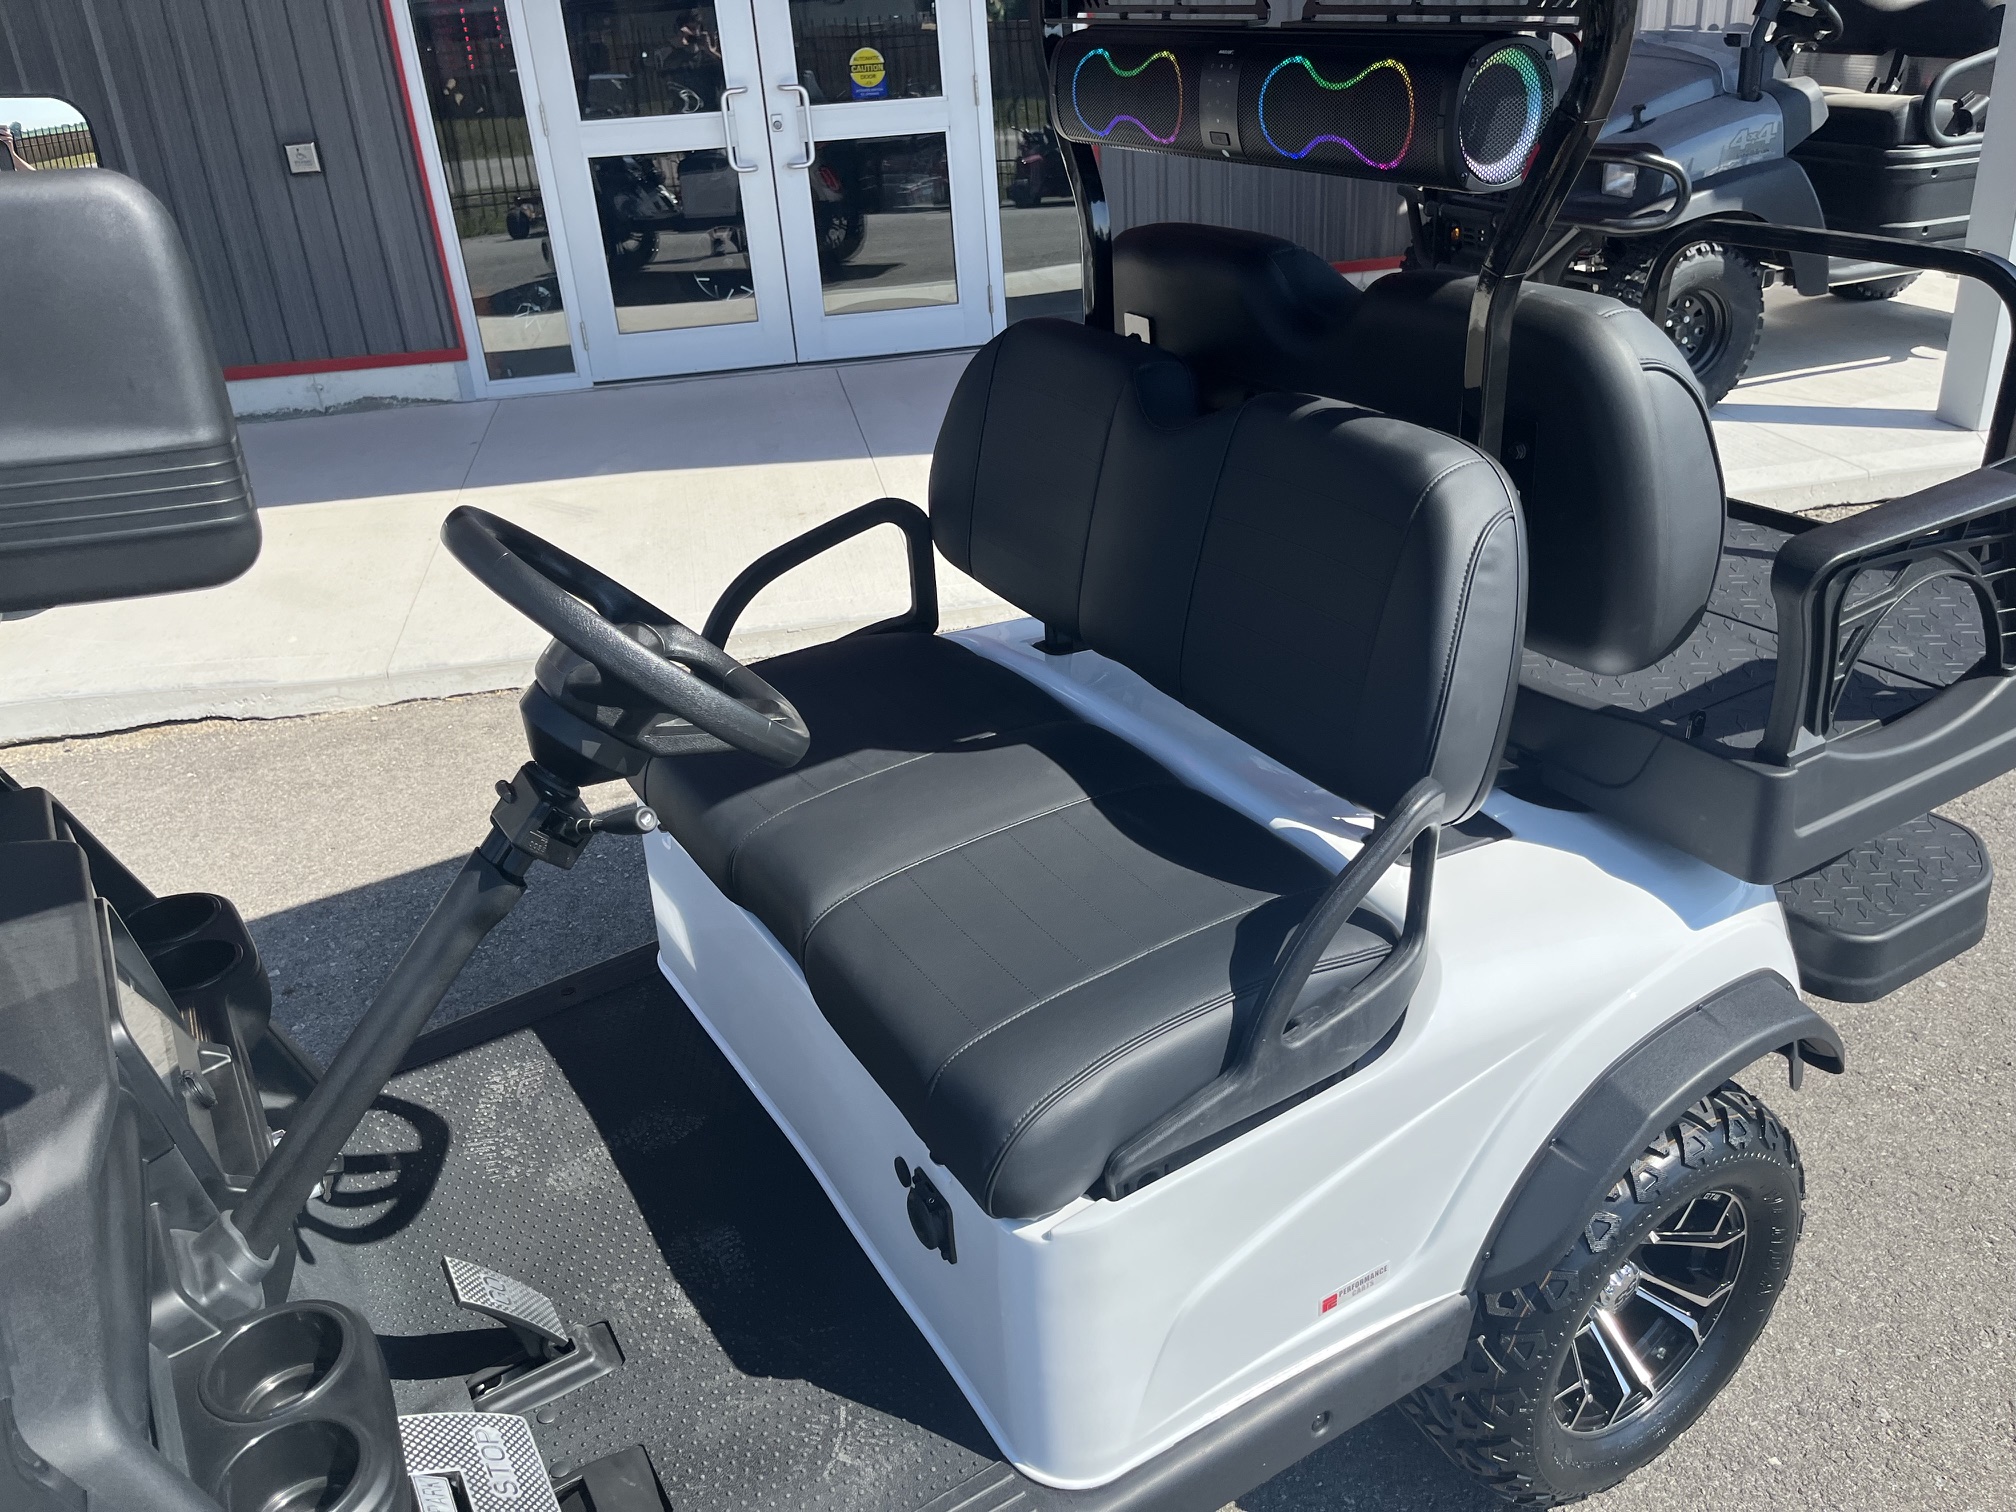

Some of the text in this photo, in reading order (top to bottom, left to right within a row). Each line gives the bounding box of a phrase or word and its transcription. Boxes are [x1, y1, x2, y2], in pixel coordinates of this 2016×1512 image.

[851, 64, 884, 73] CAUTION
[1729, 121, 1777, 150] 4x4
[483, 1276, 512, 1305] GO
[1338, 1265, 1388, 1297] PERFORMANCE
[1352, 1280, 1375, 1297] CARTS
[474, 1428, 518, 1495] STOP
[420, 1481, 448, 1512] PARK
